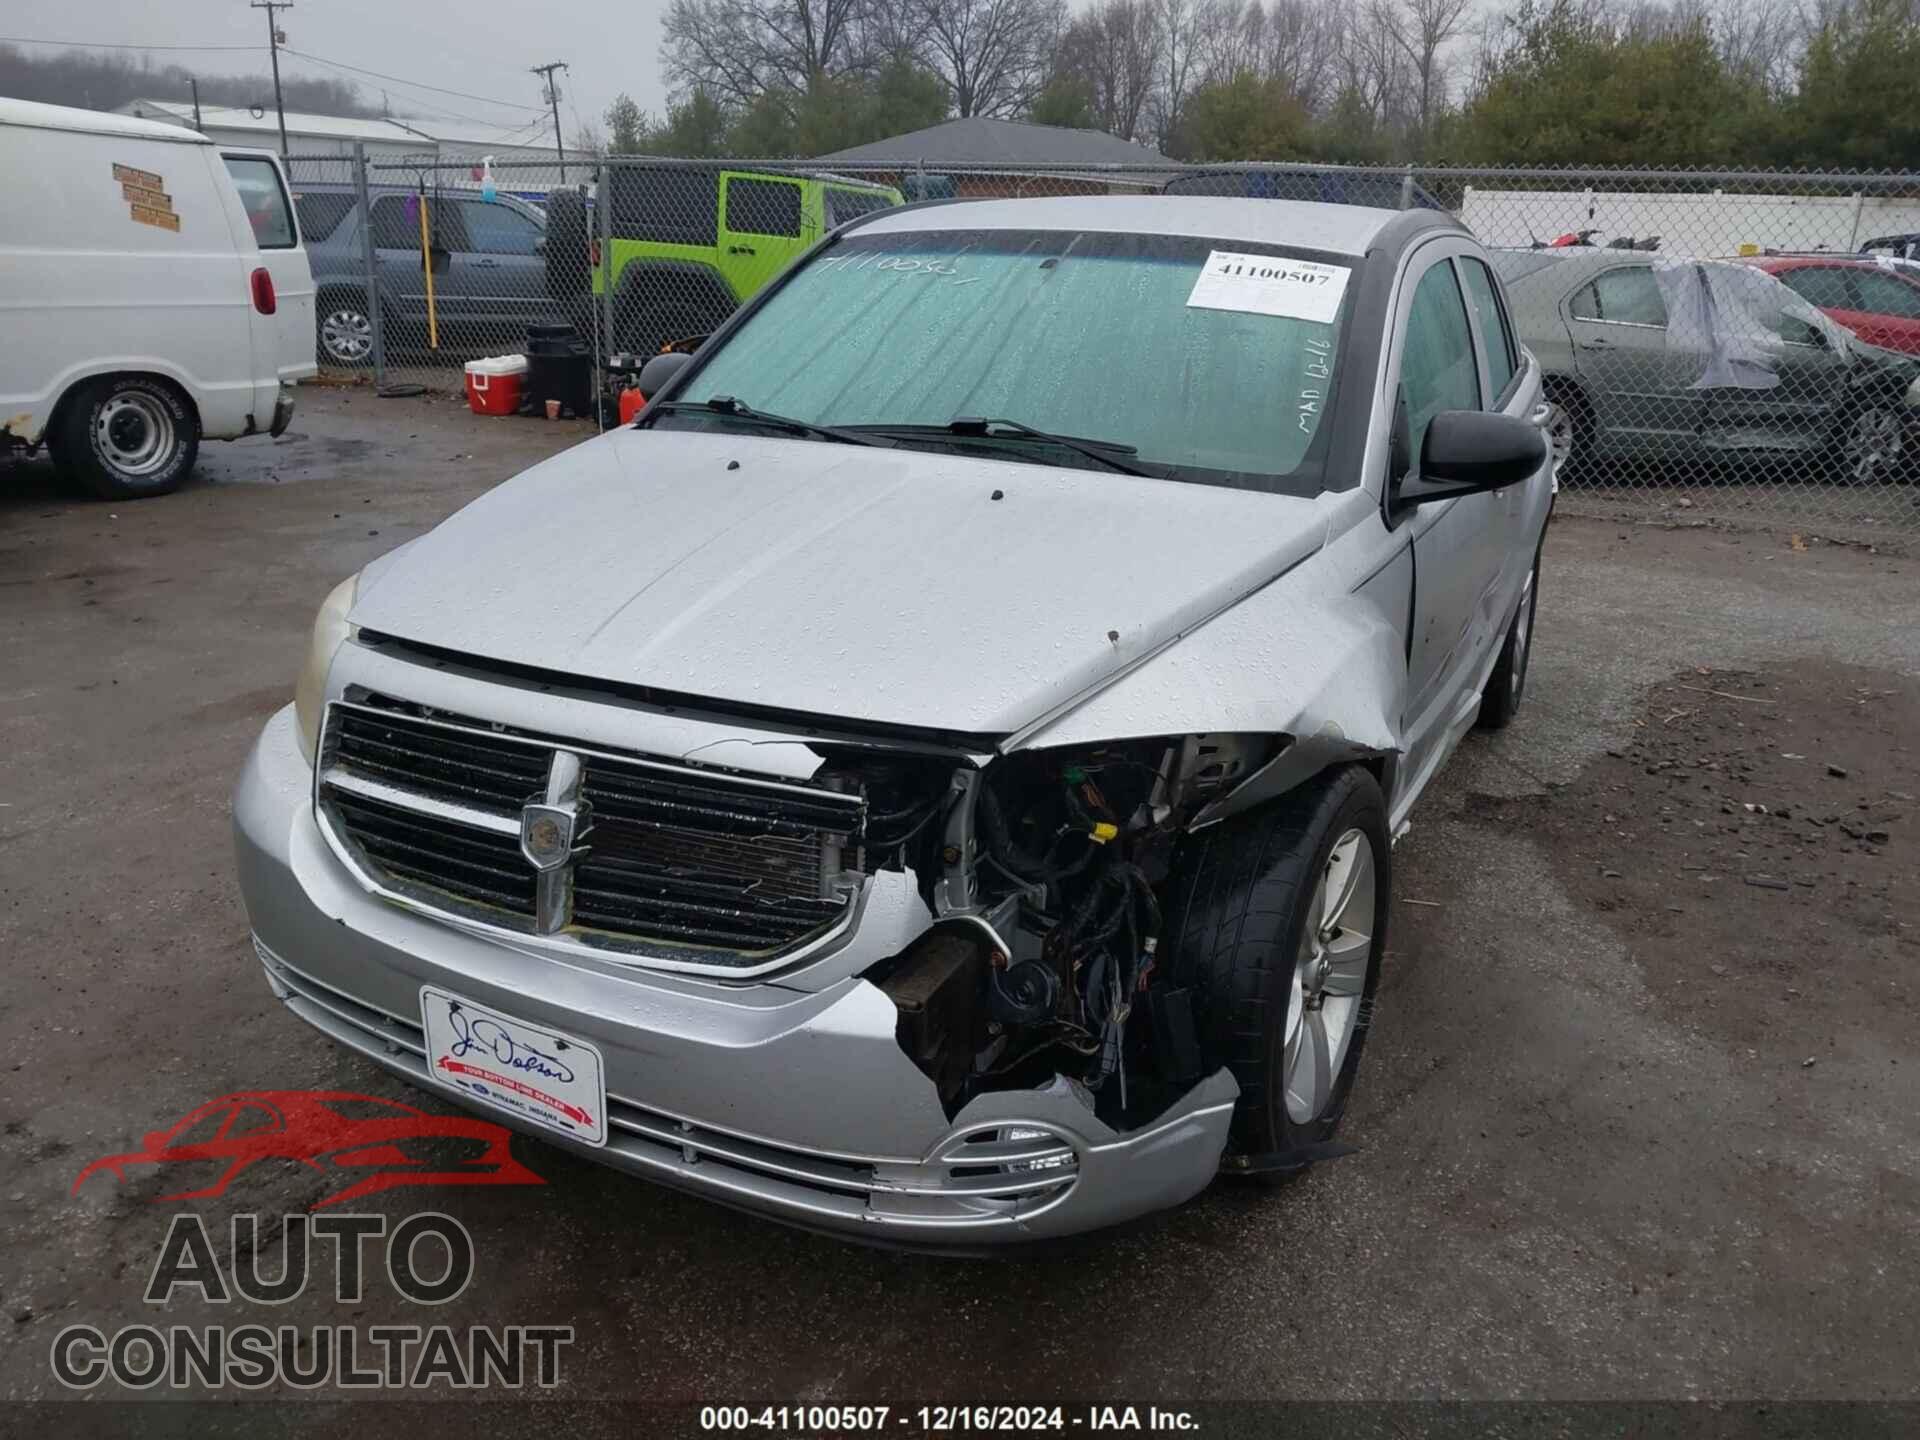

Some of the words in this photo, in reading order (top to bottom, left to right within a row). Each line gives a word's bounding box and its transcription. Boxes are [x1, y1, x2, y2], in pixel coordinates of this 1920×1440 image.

[1218, 263, 1330, 286] 41100507
[1304, 338, 1331, 379] 12-16
[534, 1090, 566, 1111] DEALER
